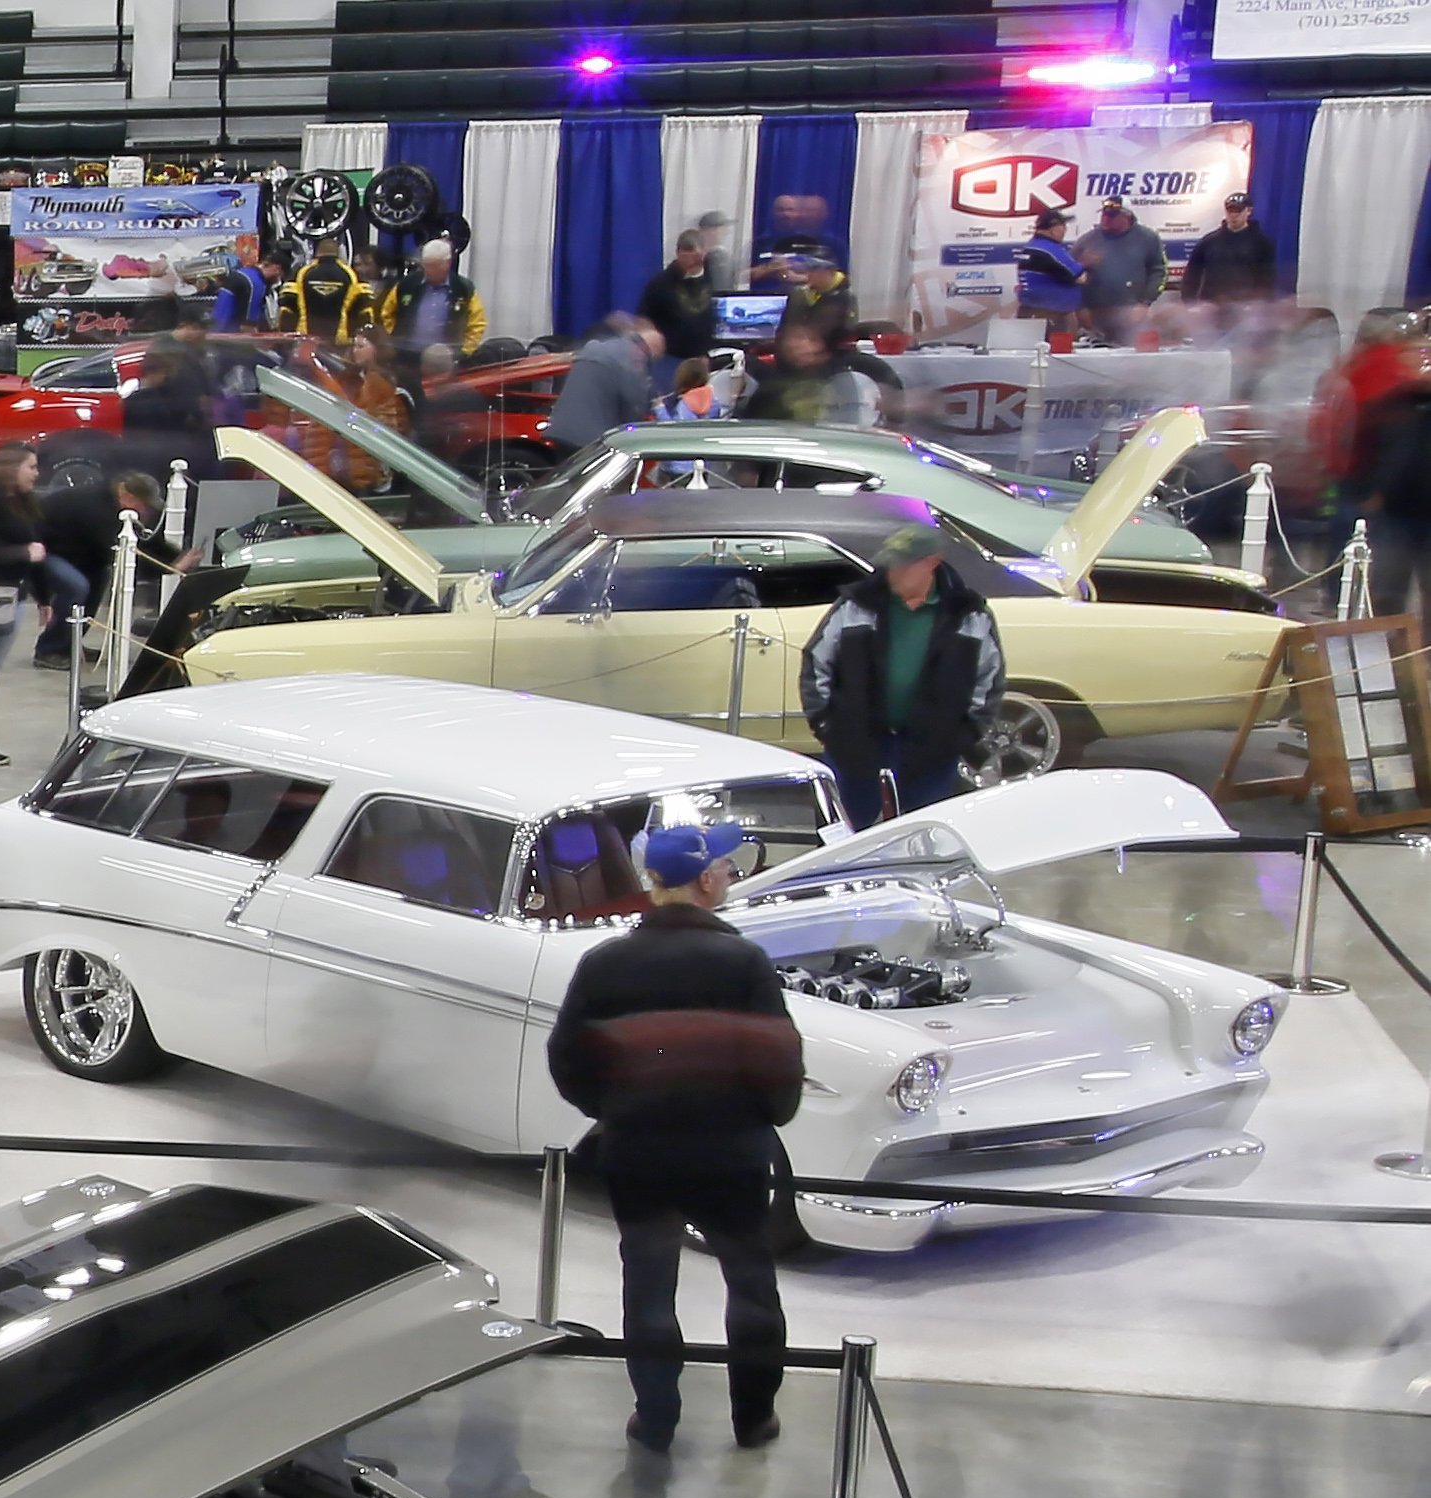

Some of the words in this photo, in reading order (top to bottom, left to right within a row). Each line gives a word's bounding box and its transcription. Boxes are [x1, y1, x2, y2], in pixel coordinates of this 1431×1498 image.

[1236, 0, 1270, 13] 2224
[1275, 0, 1312, 12] Main
[1298, 15, 1337, 28] (701)
[1341, 13, 1410, 26] 237-6525
[1086, 173, 1135, 196] TIRE
[1140, 171, 1211, 195] STORE
[28, 195, 126, 219] Plymouth
[23, 218, 105, 231] ROAD
[117, 217, 243, 230] RUNNER
